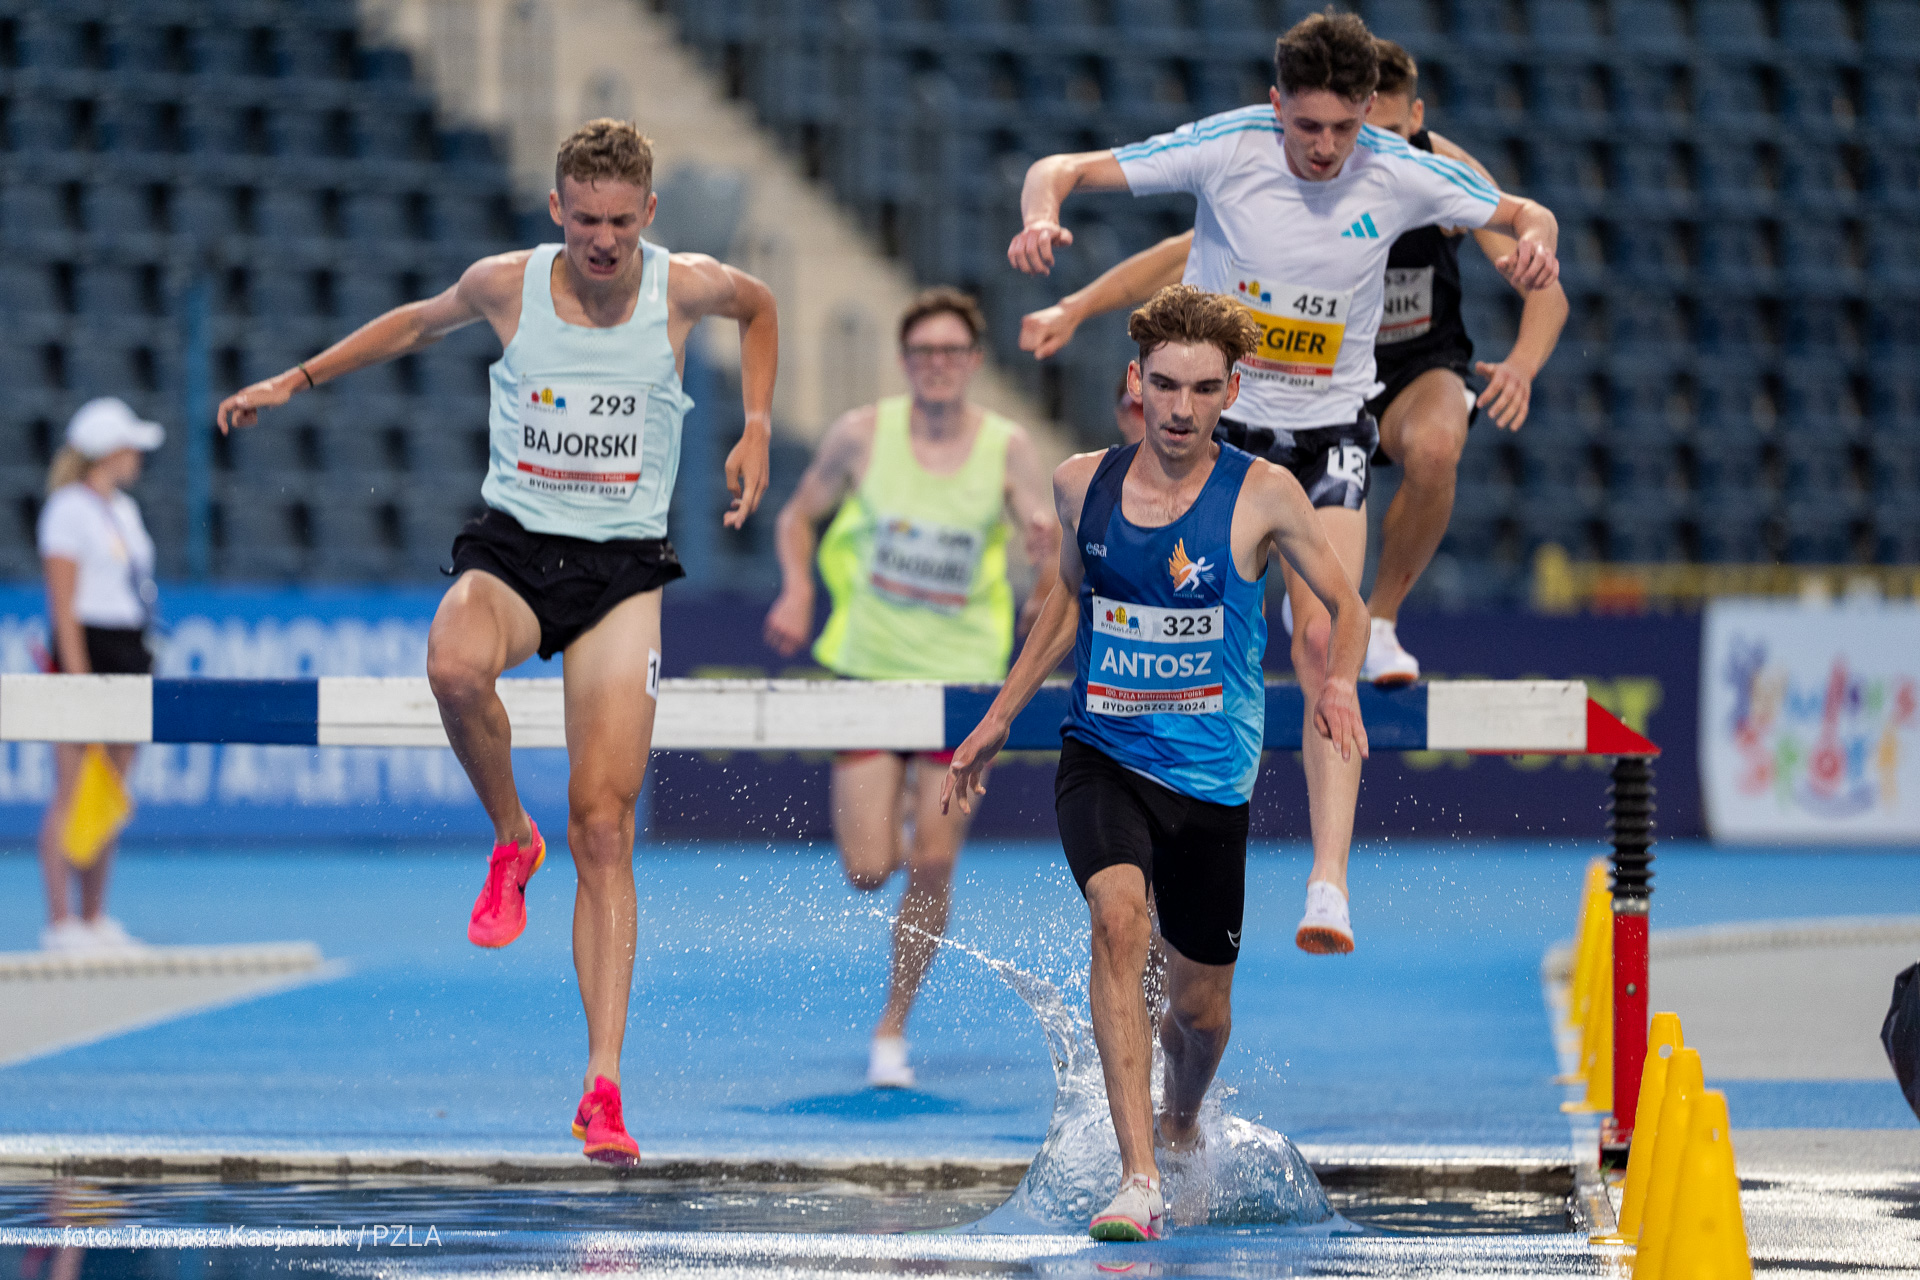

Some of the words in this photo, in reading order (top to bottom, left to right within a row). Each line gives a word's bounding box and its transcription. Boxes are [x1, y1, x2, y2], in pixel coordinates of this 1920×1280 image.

[1292, 294, 1338, 318] 451
[589, 394, 636, 416] 293
[523, 424, 637, 459] BAJORSKI
[1162, 614, 1212, 637] 323
[1099, 646, 1213, 679] ANTOSZ
[1118, 690, 1136, 700] PZLA
[1183, 688, 1205, 700] Polski
[1102, 700, 1175, 713] BYDGOSZCZ
[1177, 701, 1206, 712] 2024
